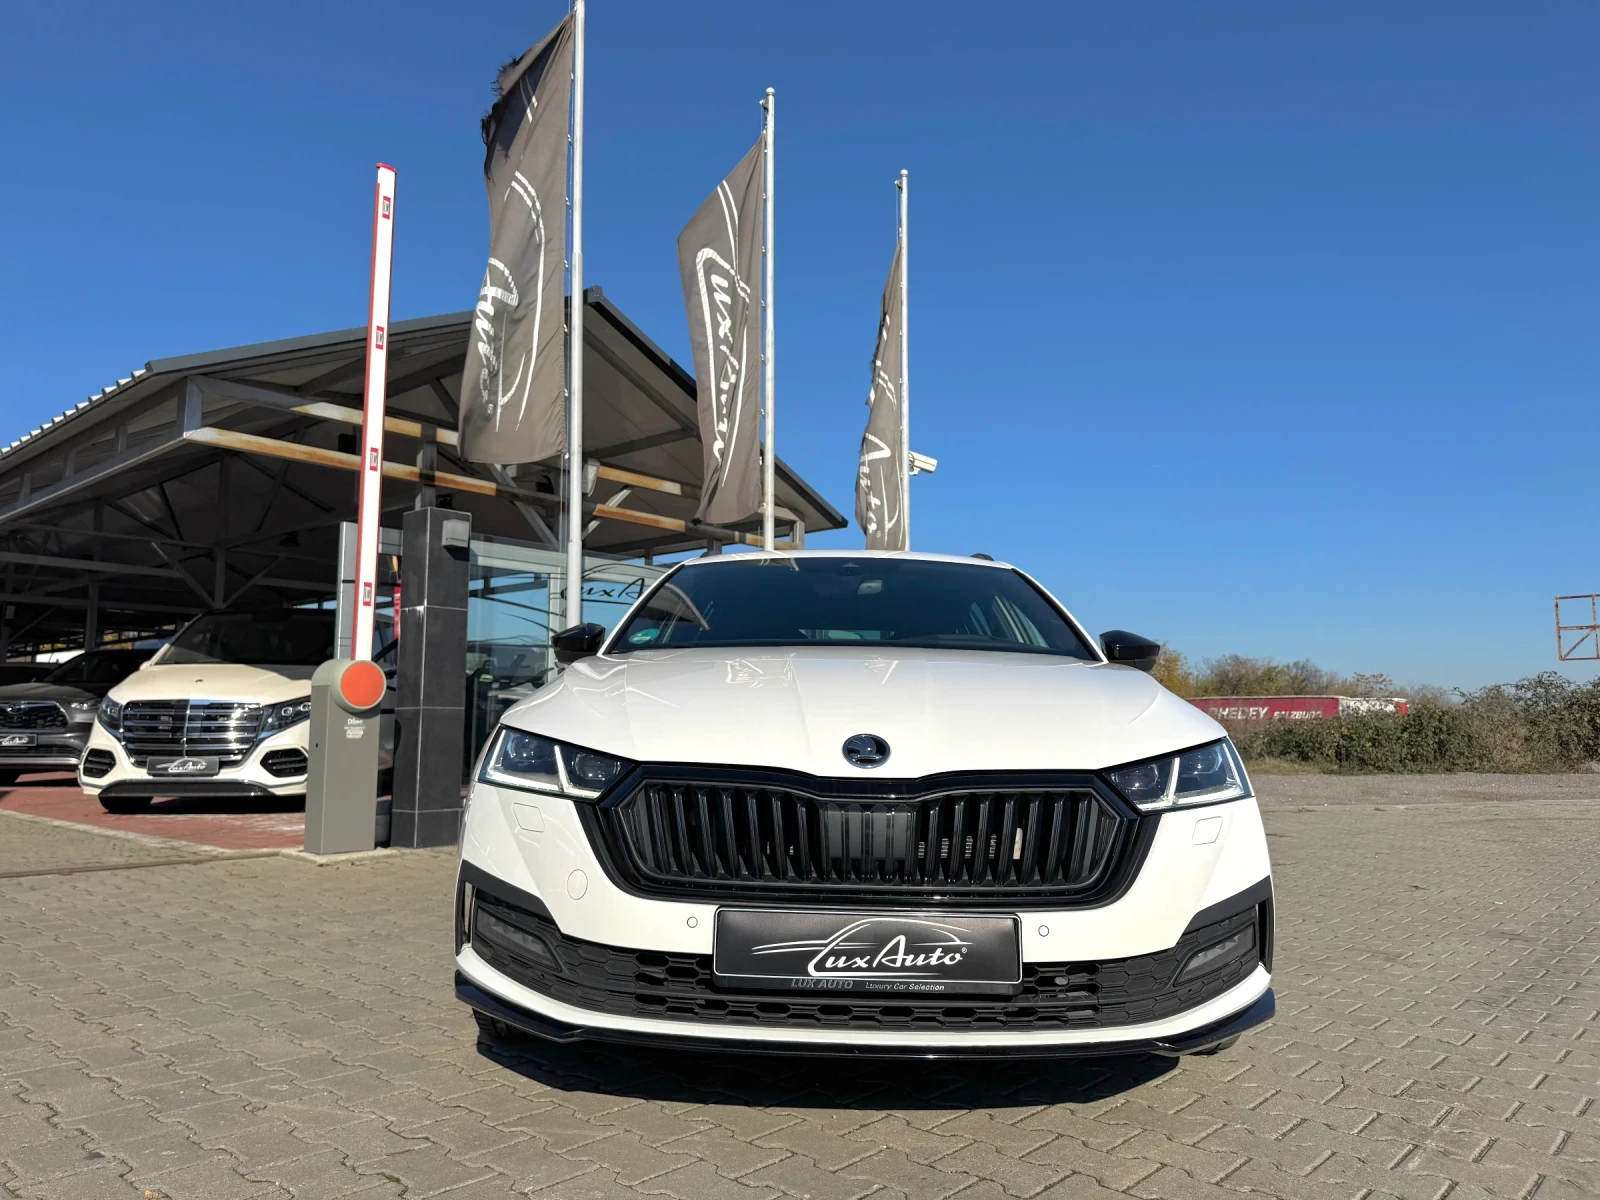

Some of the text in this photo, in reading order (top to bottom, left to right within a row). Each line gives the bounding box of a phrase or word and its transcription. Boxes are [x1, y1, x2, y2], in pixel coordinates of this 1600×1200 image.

[791, 978, 945, 991] LUX AUTO Luxury Car Selection
